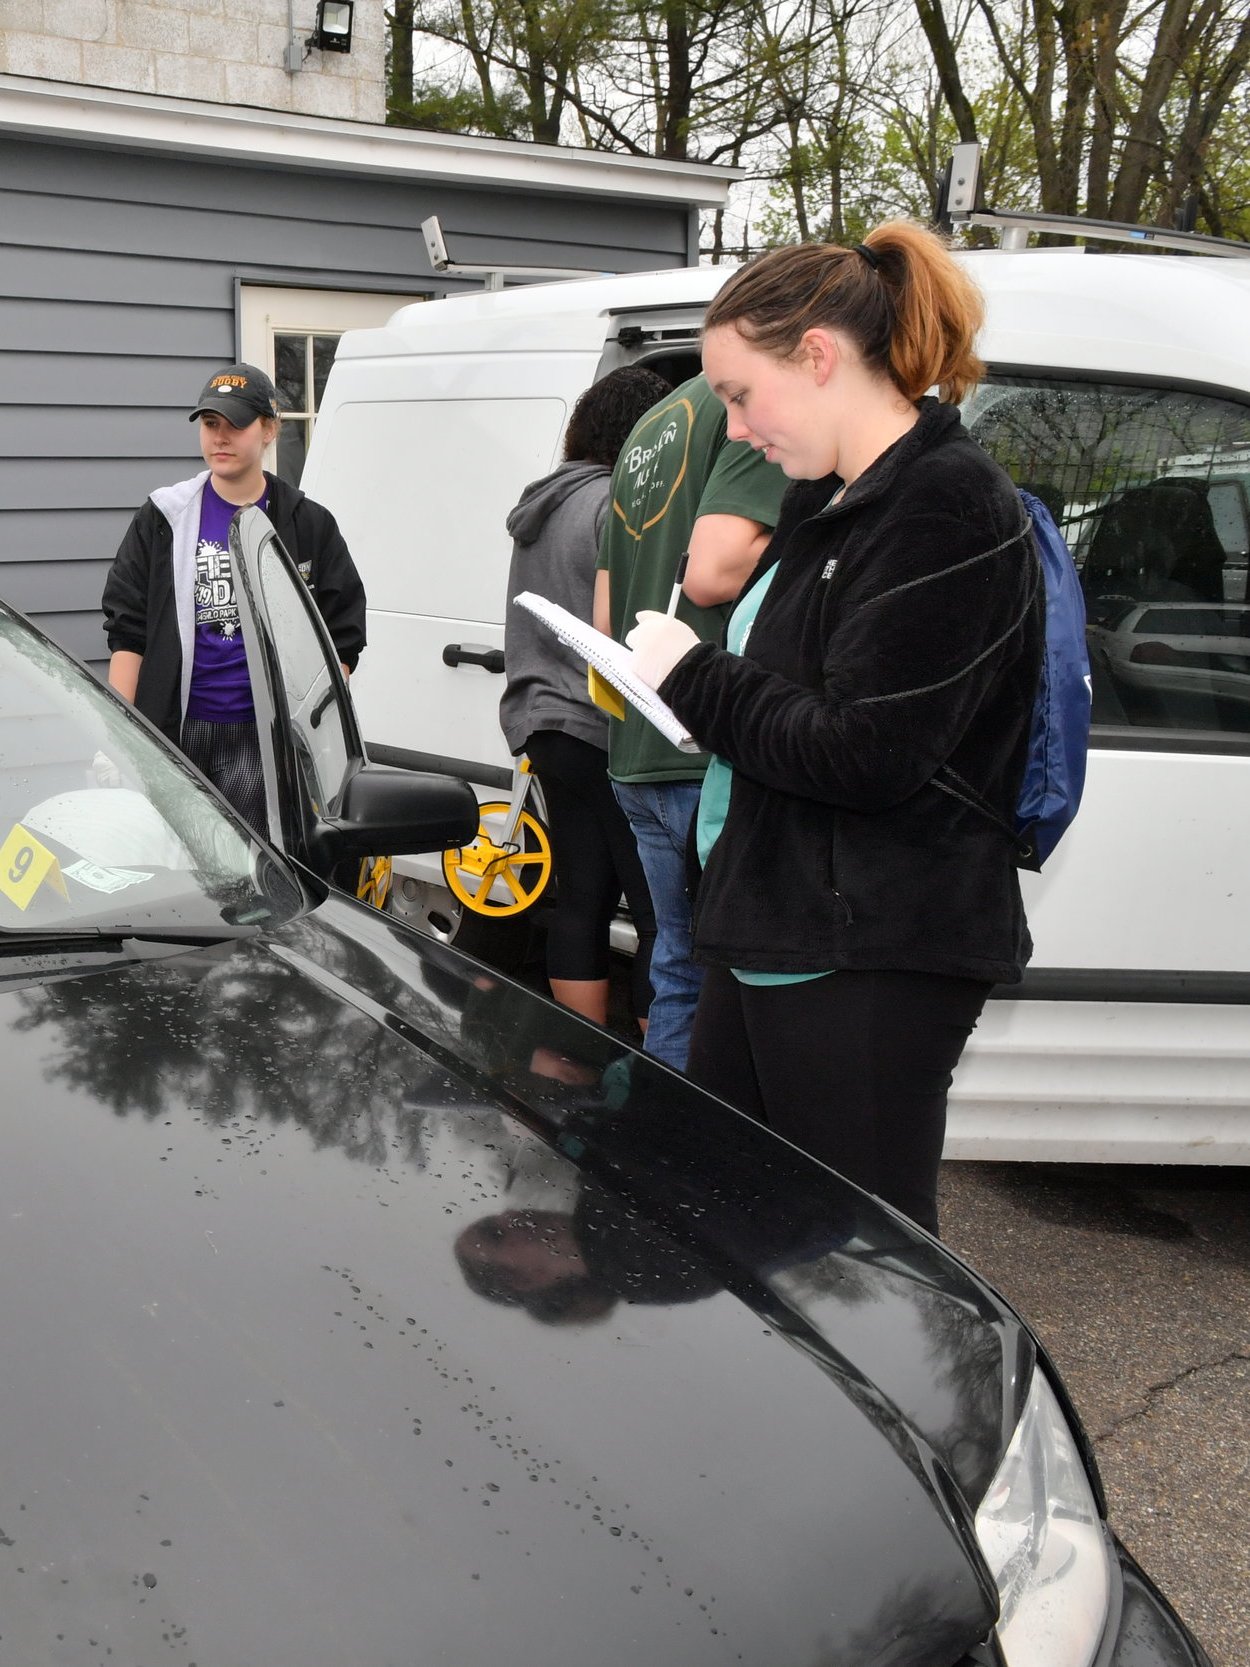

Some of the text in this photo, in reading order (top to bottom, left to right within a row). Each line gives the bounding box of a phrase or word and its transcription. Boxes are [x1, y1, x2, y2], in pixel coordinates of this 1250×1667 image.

[210, 377, 248, 389] RUGBY
[195, 555, 232, 580] FIE
[219, 607, 237, 619] PARK
[7, 846, 35, 883] 9
